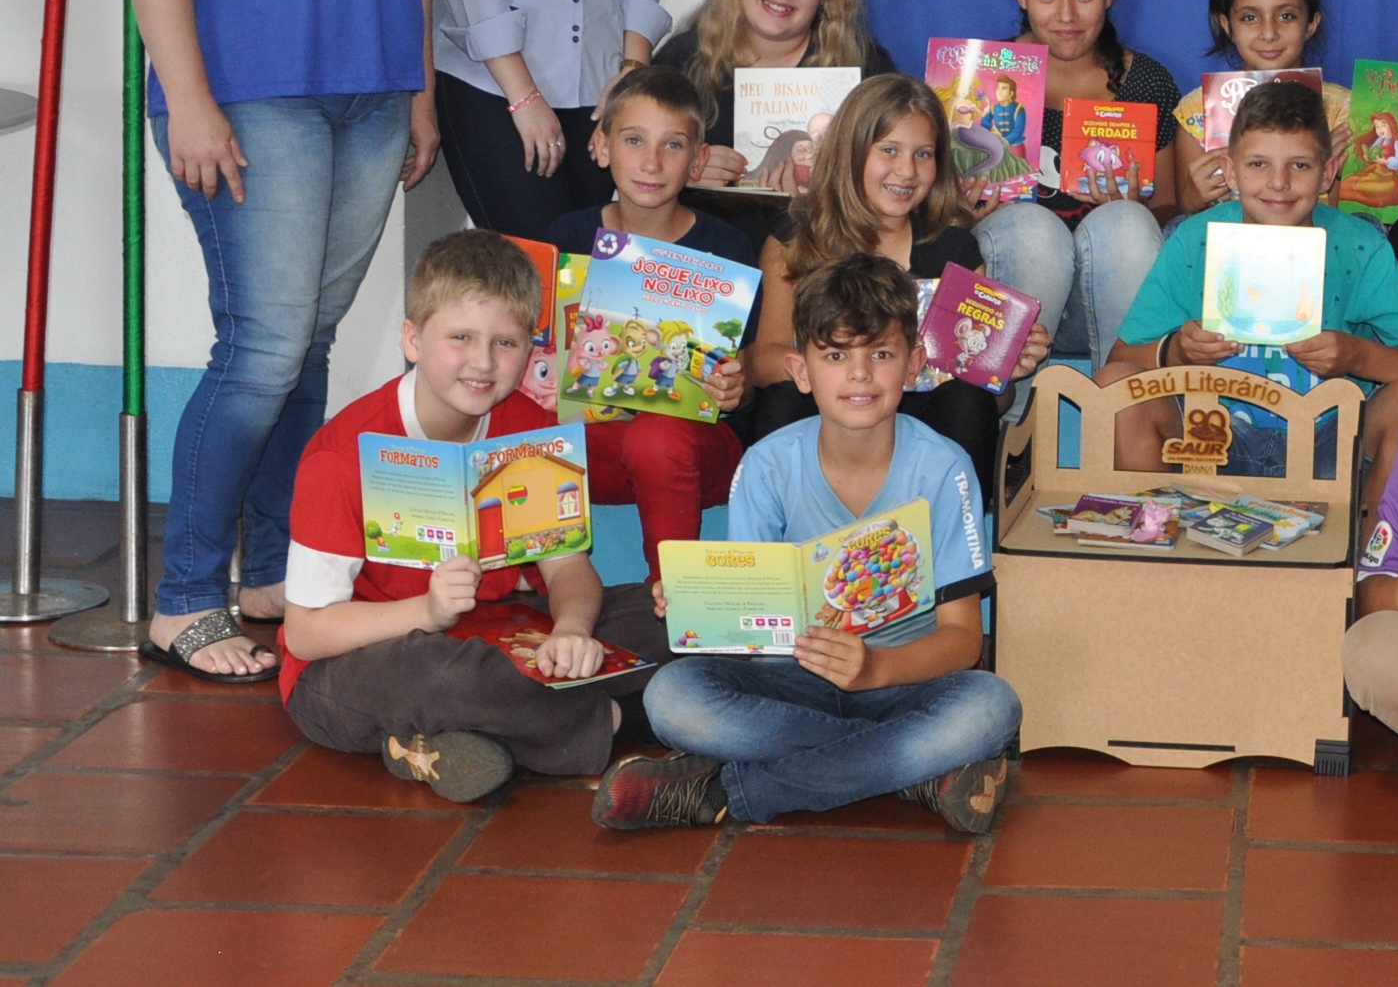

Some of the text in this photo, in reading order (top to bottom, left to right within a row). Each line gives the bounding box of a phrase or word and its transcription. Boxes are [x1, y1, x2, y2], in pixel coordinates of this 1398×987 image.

[740, 80, 819, 97] MEU BISAVÔ
[750, 101, 808, 115] ITALIANO
[1081, 126, 1138, 139] VERDADE
[632, 257, 735, 296] JOGUE LIXO
[642, 275, 715, 306] NO LIXO
[957, 302, 1005, 330] REGRAS
[965, 298, 994, 314] SEGUINDO
[1128, 371, 1282, 406] Baú Literário
[1167, 444, 1225, 456] SAUR
[954, 472, 984, 570] TRAMONTINA
